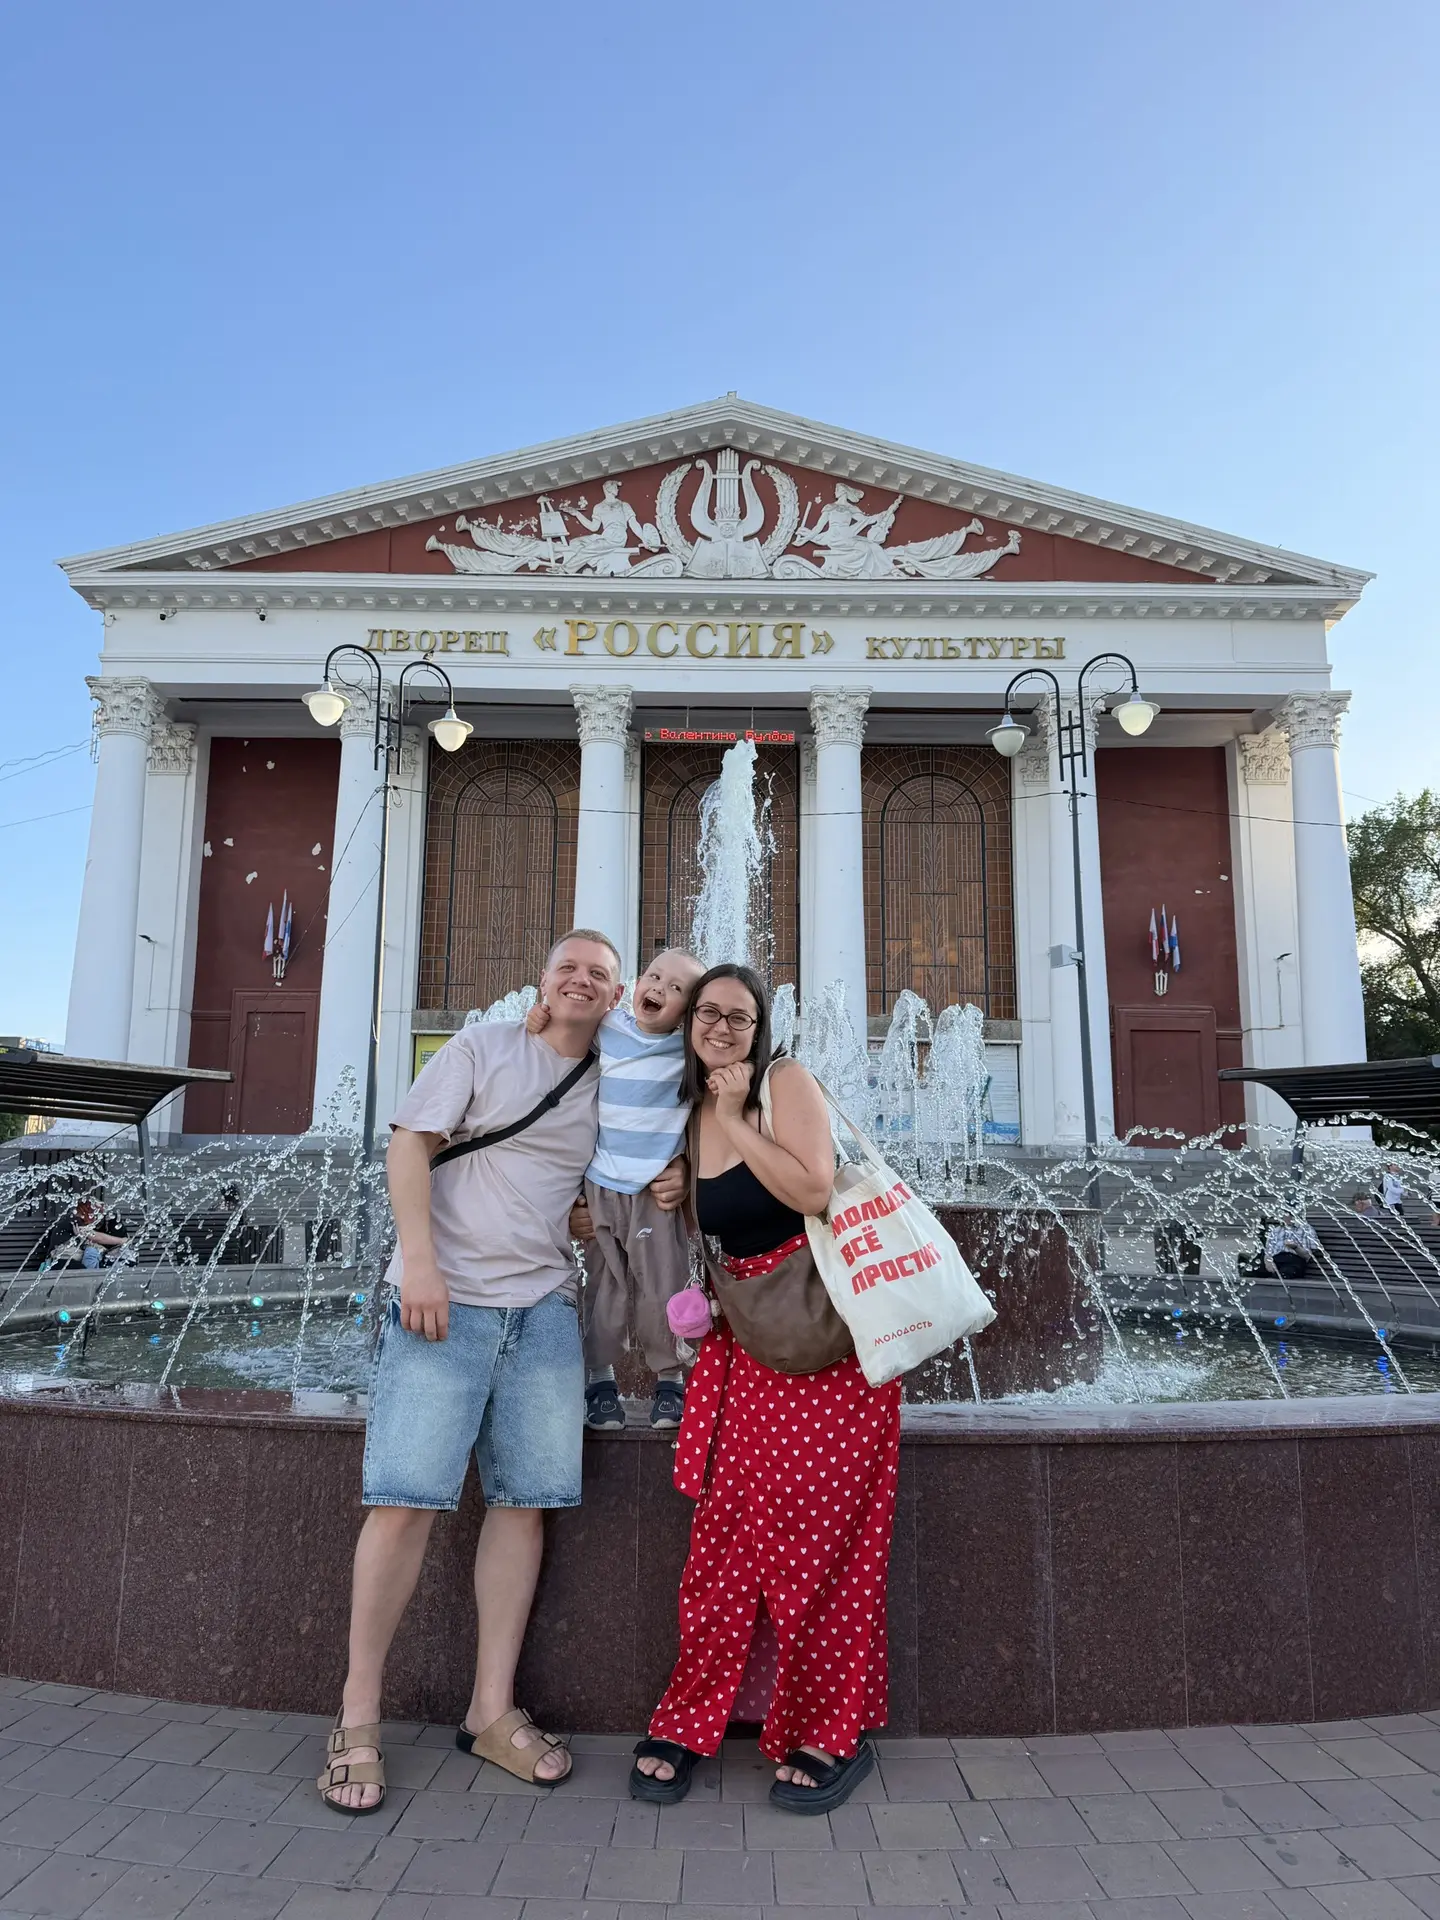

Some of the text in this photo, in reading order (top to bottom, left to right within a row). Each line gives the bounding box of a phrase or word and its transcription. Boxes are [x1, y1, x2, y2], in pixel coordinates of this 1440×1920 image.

[365, 618, 1066, 660] ДВОРЕЦ «РОССИЯ» КУЛЬТУРЫ
[660, 728, 737, 742] Валентина
[840, 1224, 884, 1268] ВСЁ
[851, 1241, 943, 1296] ПРОСТИТ
[873, 1320, 933, 1347] МОЛОДОСТЬ
